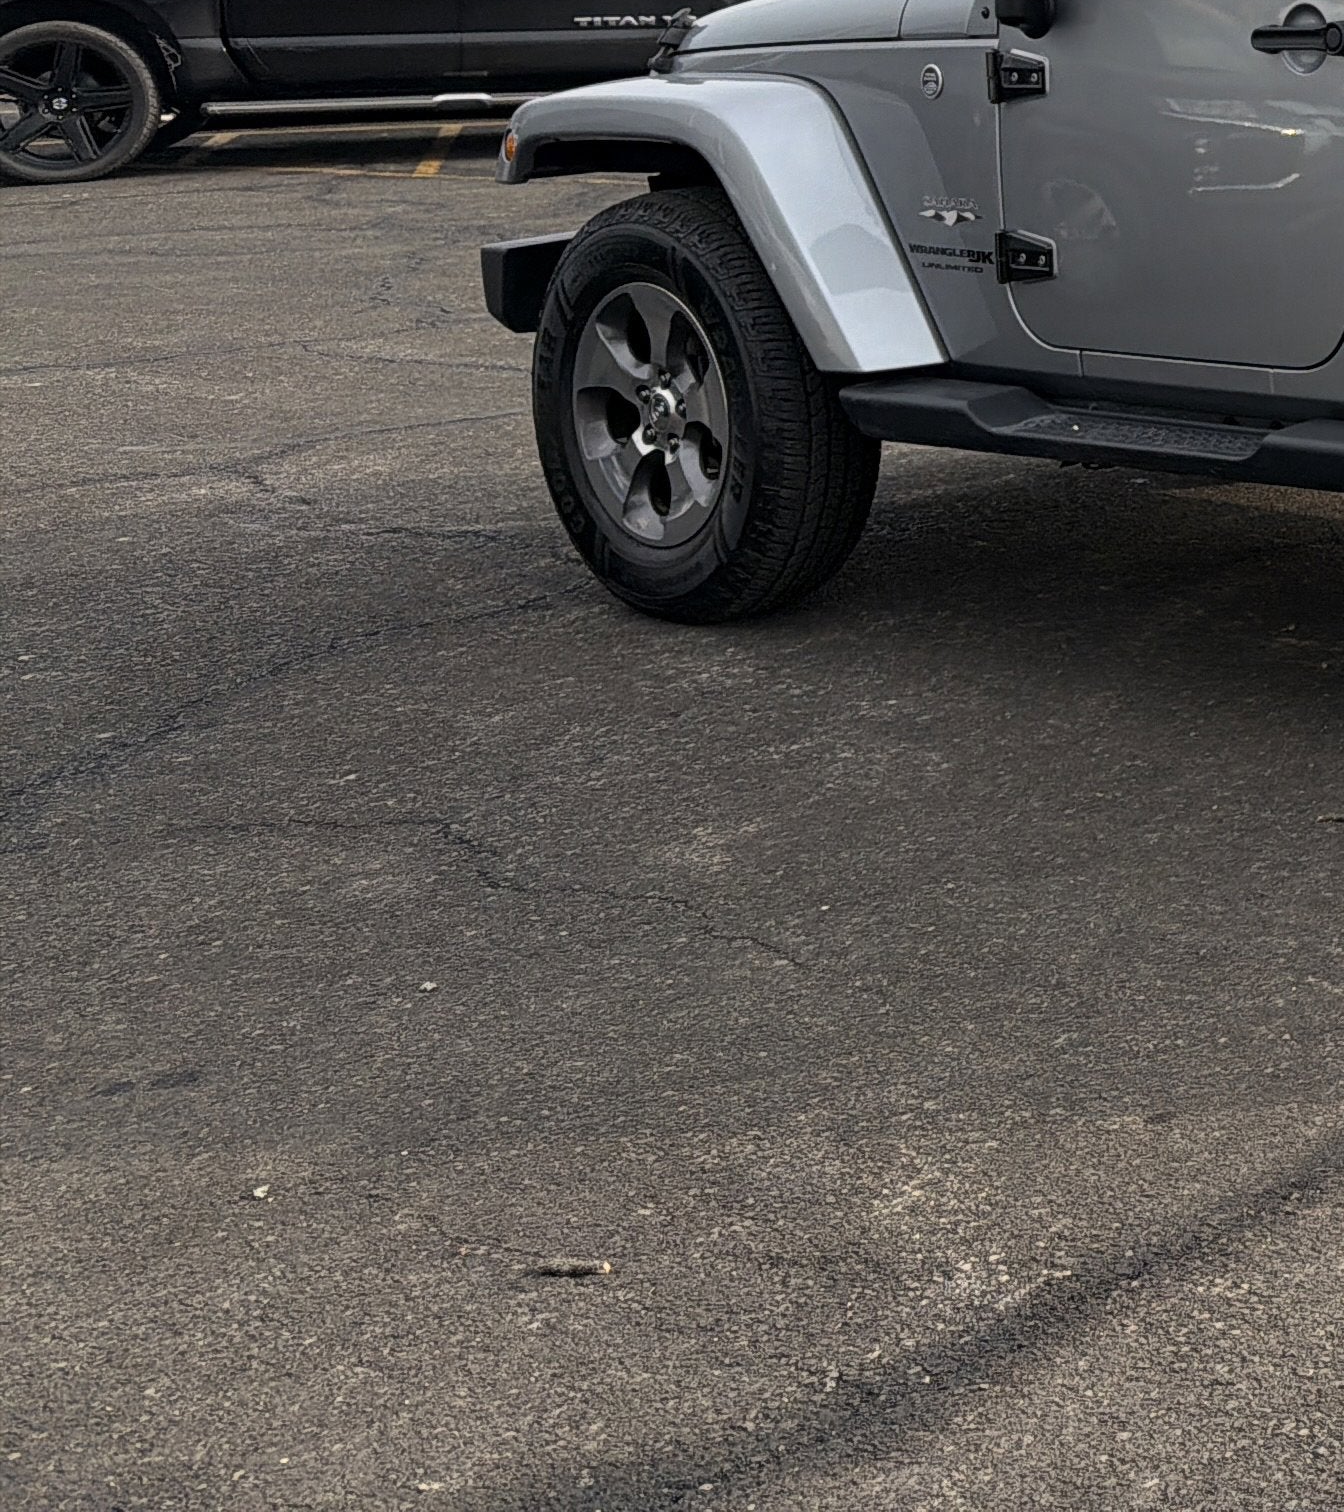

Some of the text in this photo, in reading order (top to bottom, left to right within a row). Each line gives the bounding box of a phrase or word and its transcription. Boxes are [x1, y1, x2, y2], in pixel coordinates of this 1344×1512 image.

[573, 15, 656, 27] TITAN
[923, 195, 979, 210] SAHARA
[922, 262, 984, 274] UNLIMITED
